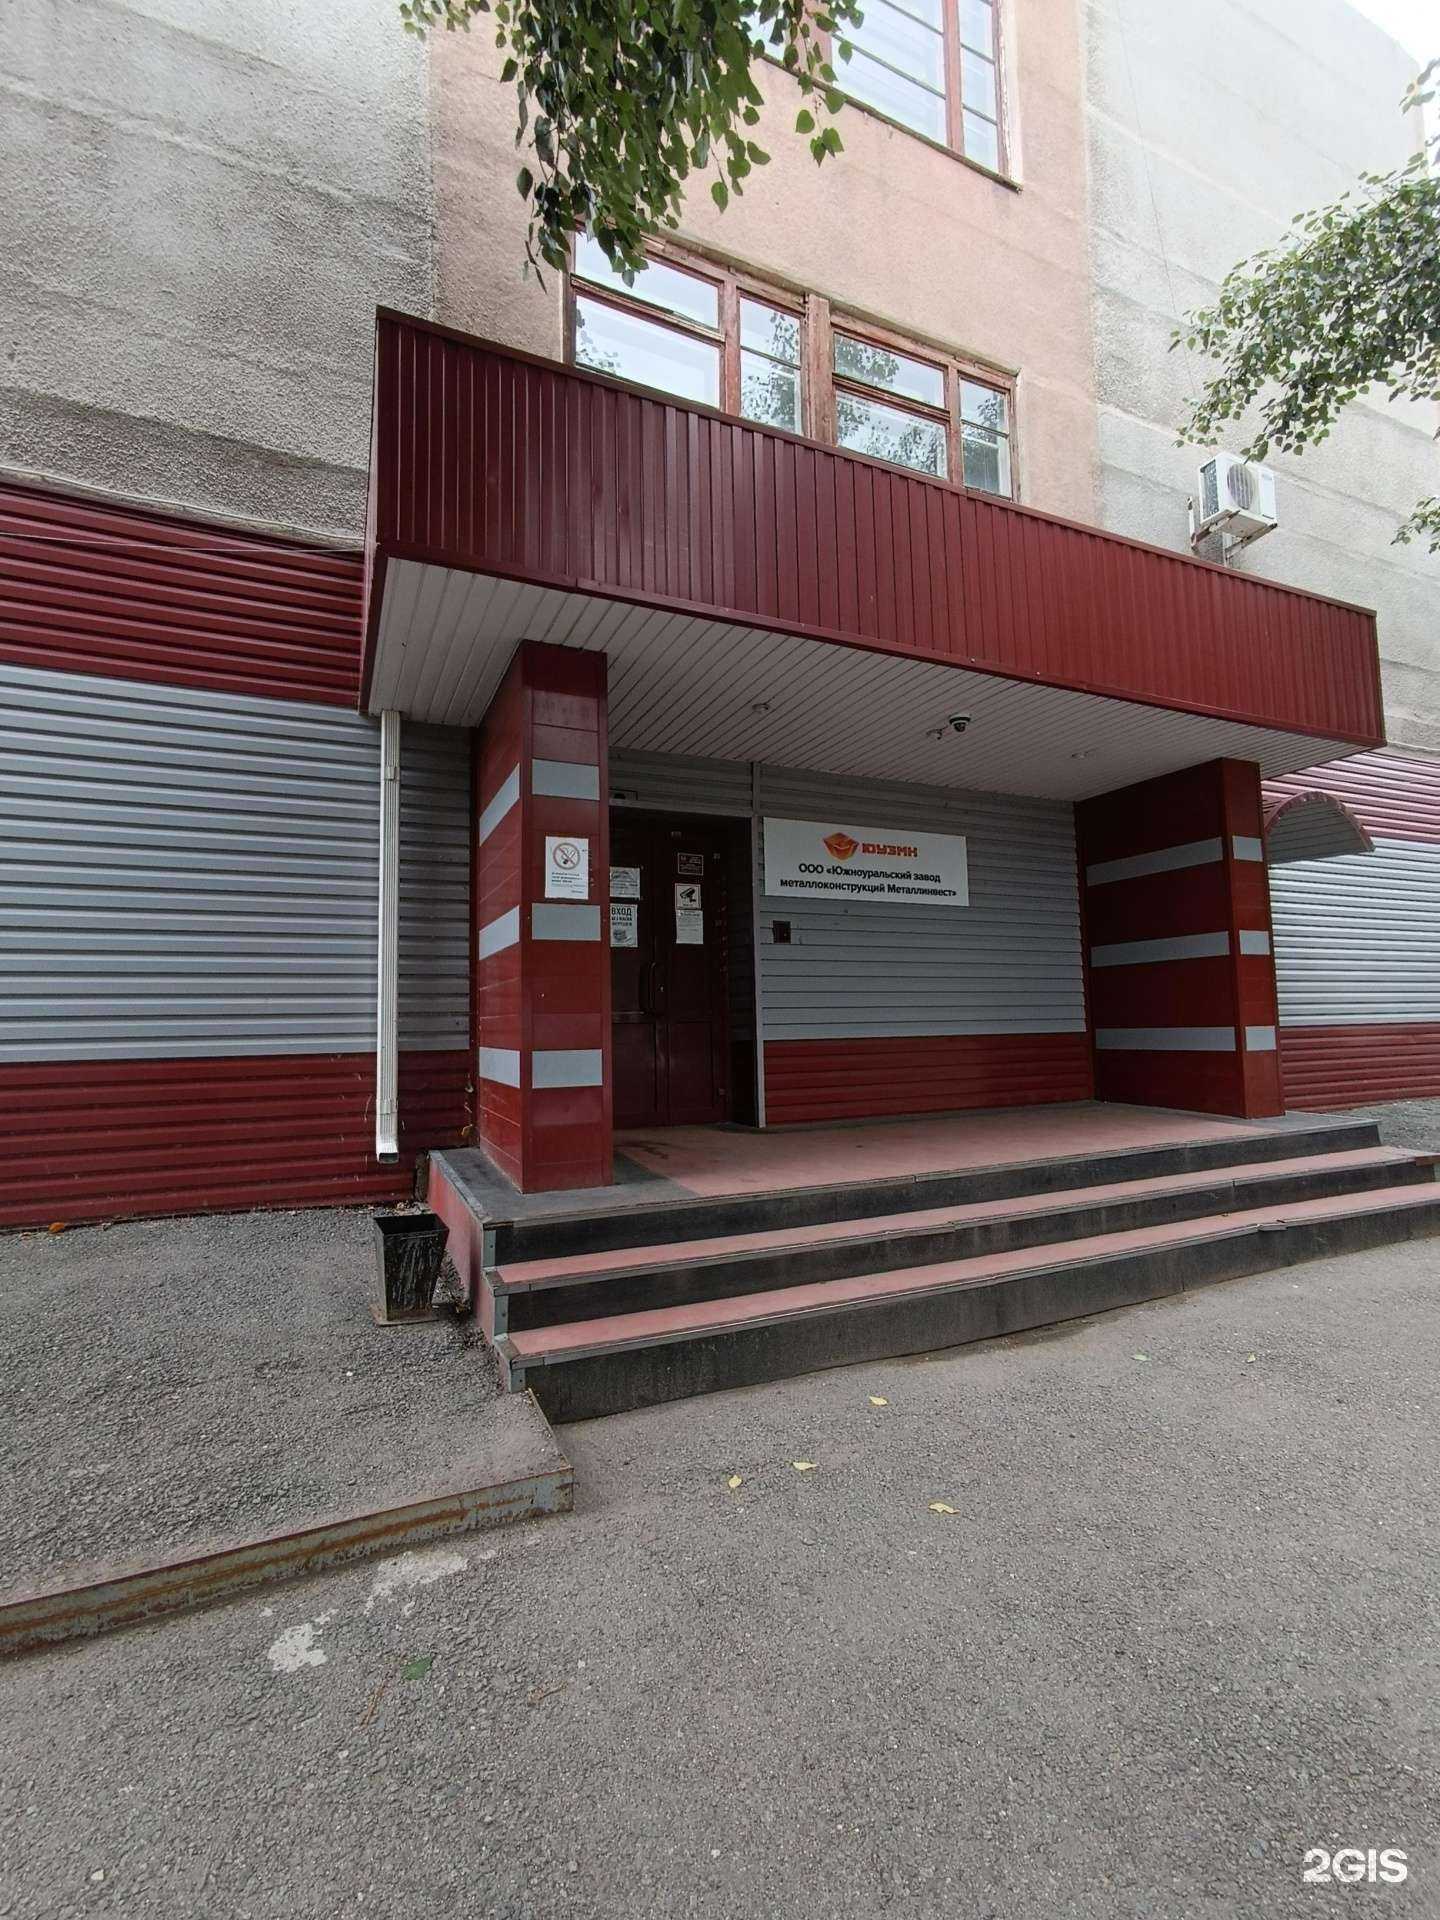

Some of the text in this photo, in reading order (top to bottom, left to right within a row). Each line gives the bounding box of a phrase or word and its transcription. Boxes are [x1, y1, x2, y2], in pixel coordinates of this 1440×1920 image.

[798, 863, 941, 883] ООО «Южноуральский завод
[780, 879, 957, 896] металлоконструкций Металлинвест»
[611, 906, 632, 916] ВХОД
